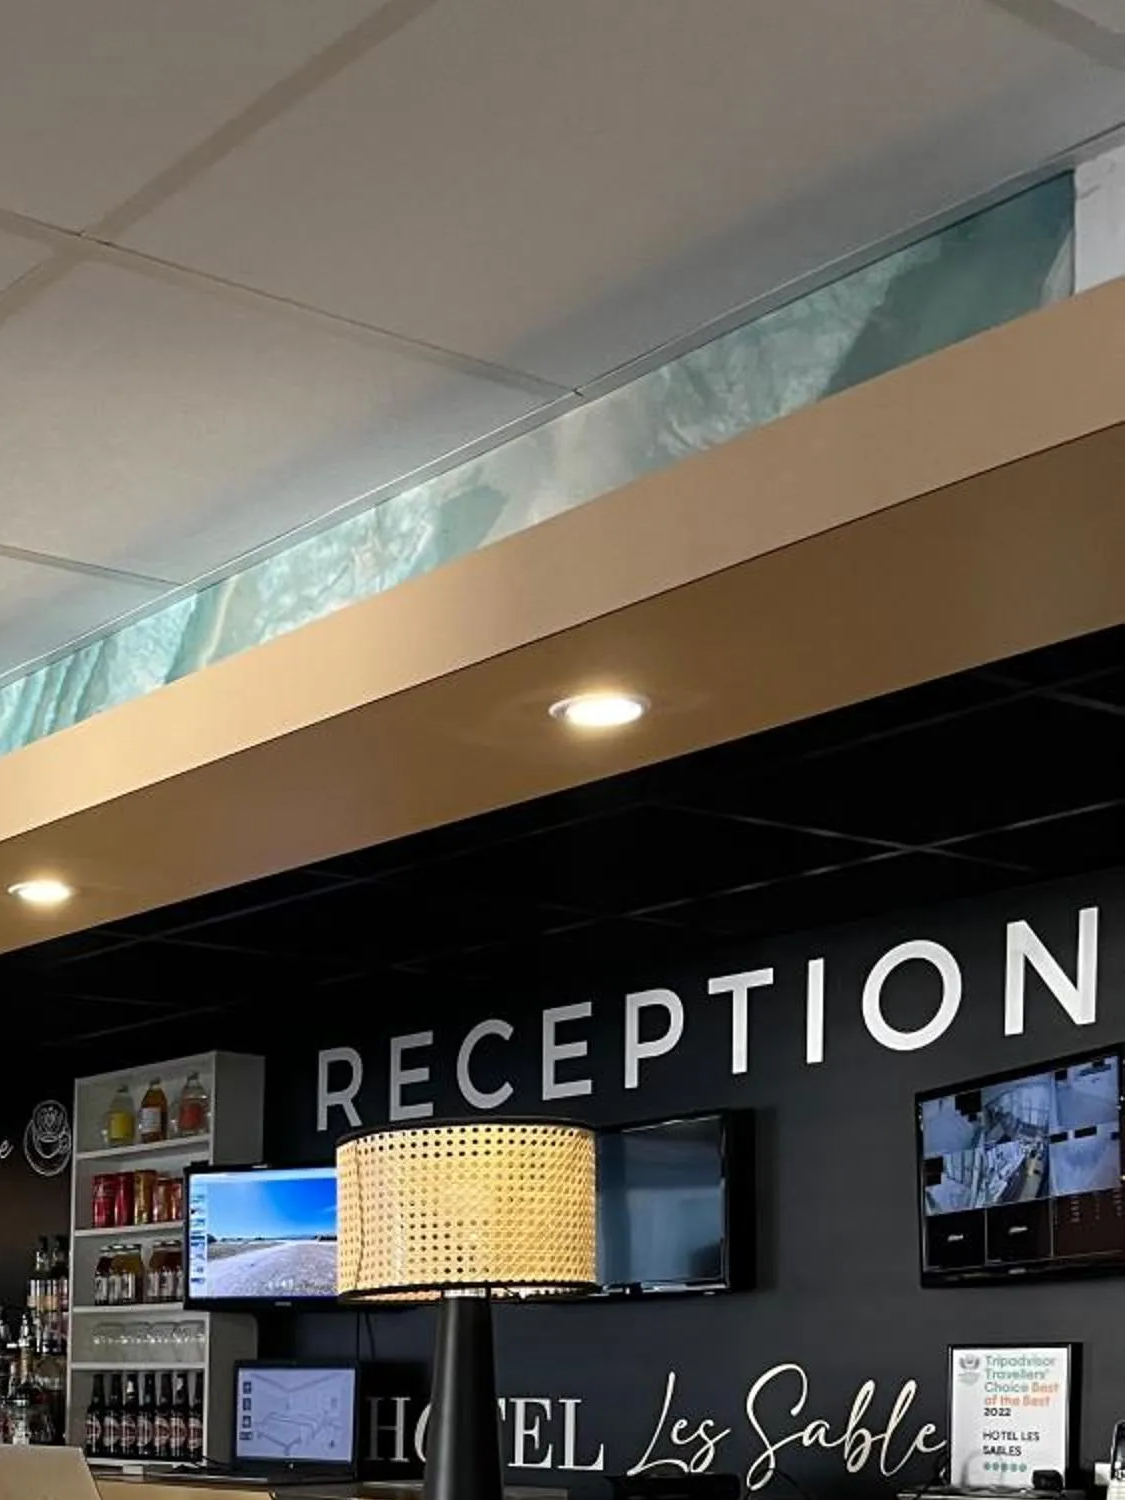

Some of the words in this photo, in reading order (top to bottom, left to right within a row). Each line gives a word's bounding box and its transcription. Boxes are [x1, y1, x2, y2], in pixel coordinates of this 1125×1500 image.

[316, 906, 1100, 1132] RECEPTION
[985, 1355, 1056, 1368] Tripadvisor
[984, 1382, 1029, 1393] Choice
[1031, 1382, 1059, 1393] Best
[985, 1396, 997, 1406] of
[1000, 1396, 1020, 1406] the
[1023, 1396, 1051, 1407] Best
[984, 1408, 1011, 1417] 2022
[366, 1396, 605, 1471] HEL
[627, 1371, 731, 1476] Les
[983, 1432, 1018, 1441] HOTEL
[1021, 1432, 1040, 1441] LES
[983, 1446, 1022, 1456] SABLES
